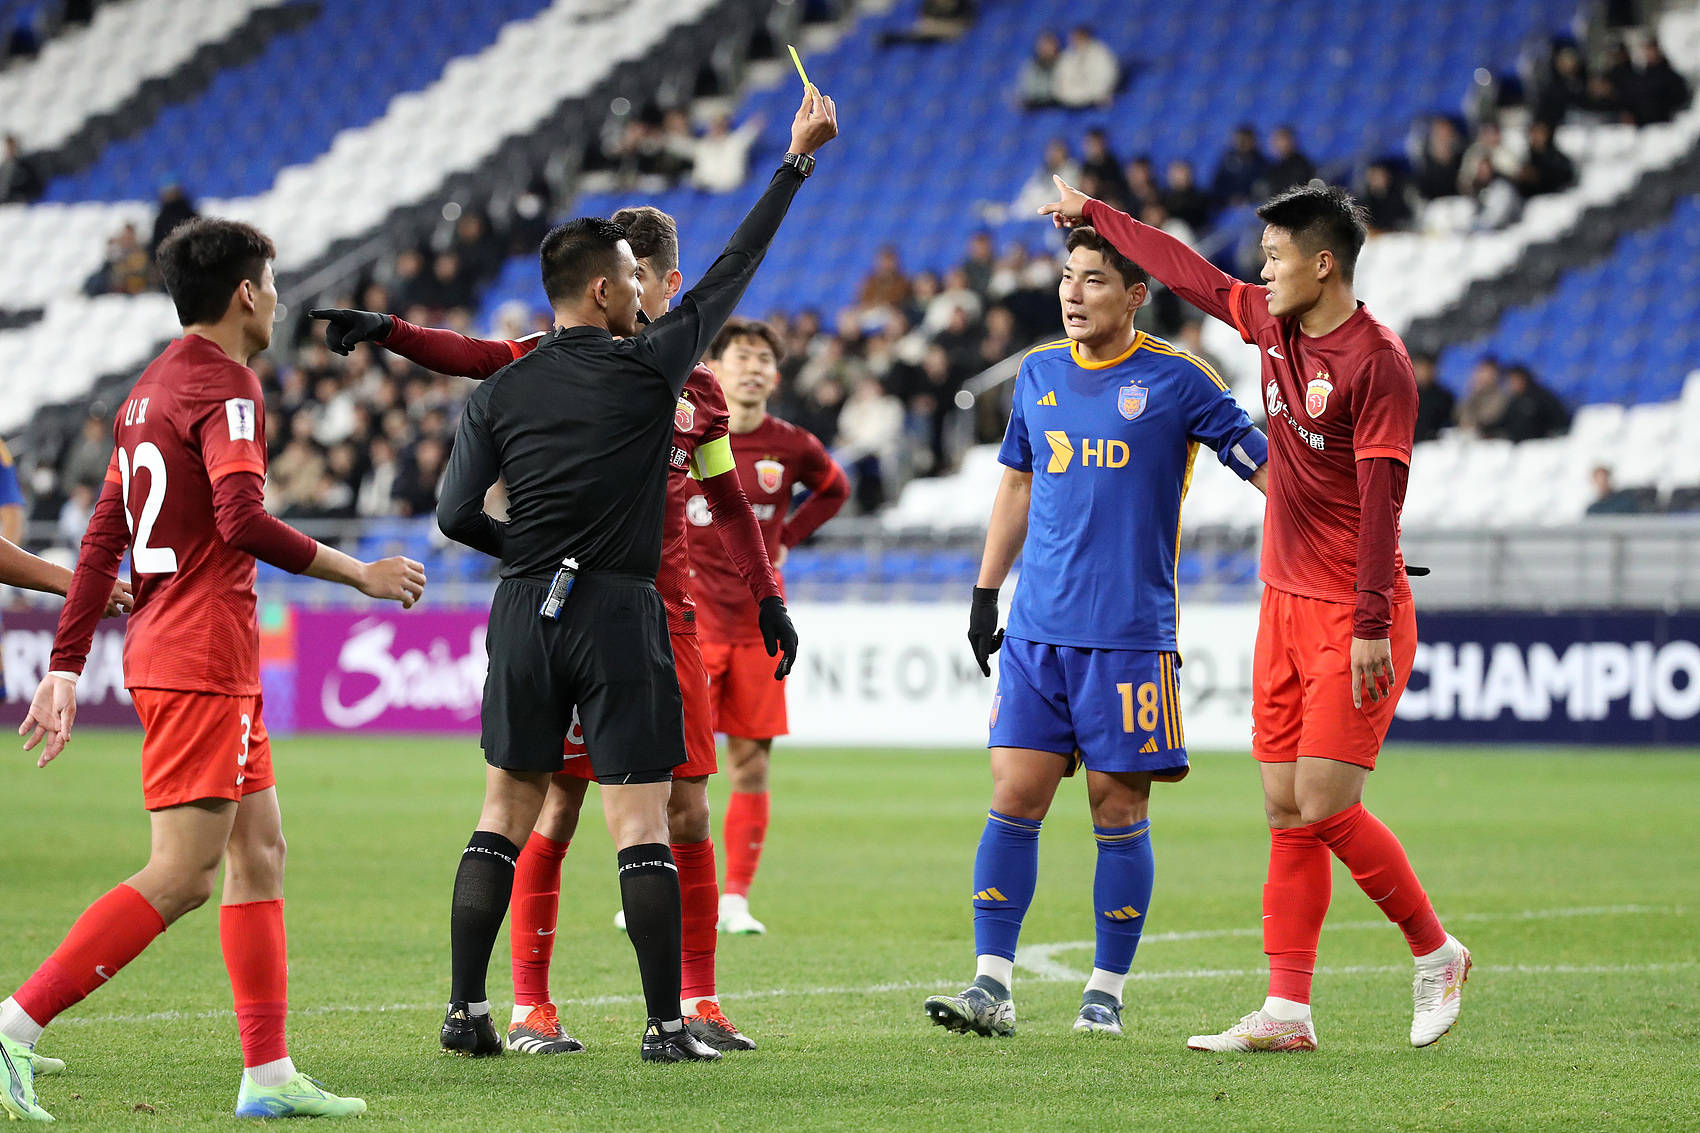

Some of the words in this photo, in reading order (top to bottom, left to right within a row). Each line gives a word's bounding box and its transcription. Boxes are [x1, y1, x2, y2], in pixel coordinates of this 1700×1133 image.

[1082, 438, 1130, 468] HD
[1395, 640, 1700, 721] CHAMPIO
[1116, 682, 1159, 733] 18
[469, 846, 512, 863] KELME
[619, 860, 663, 875] KELME
